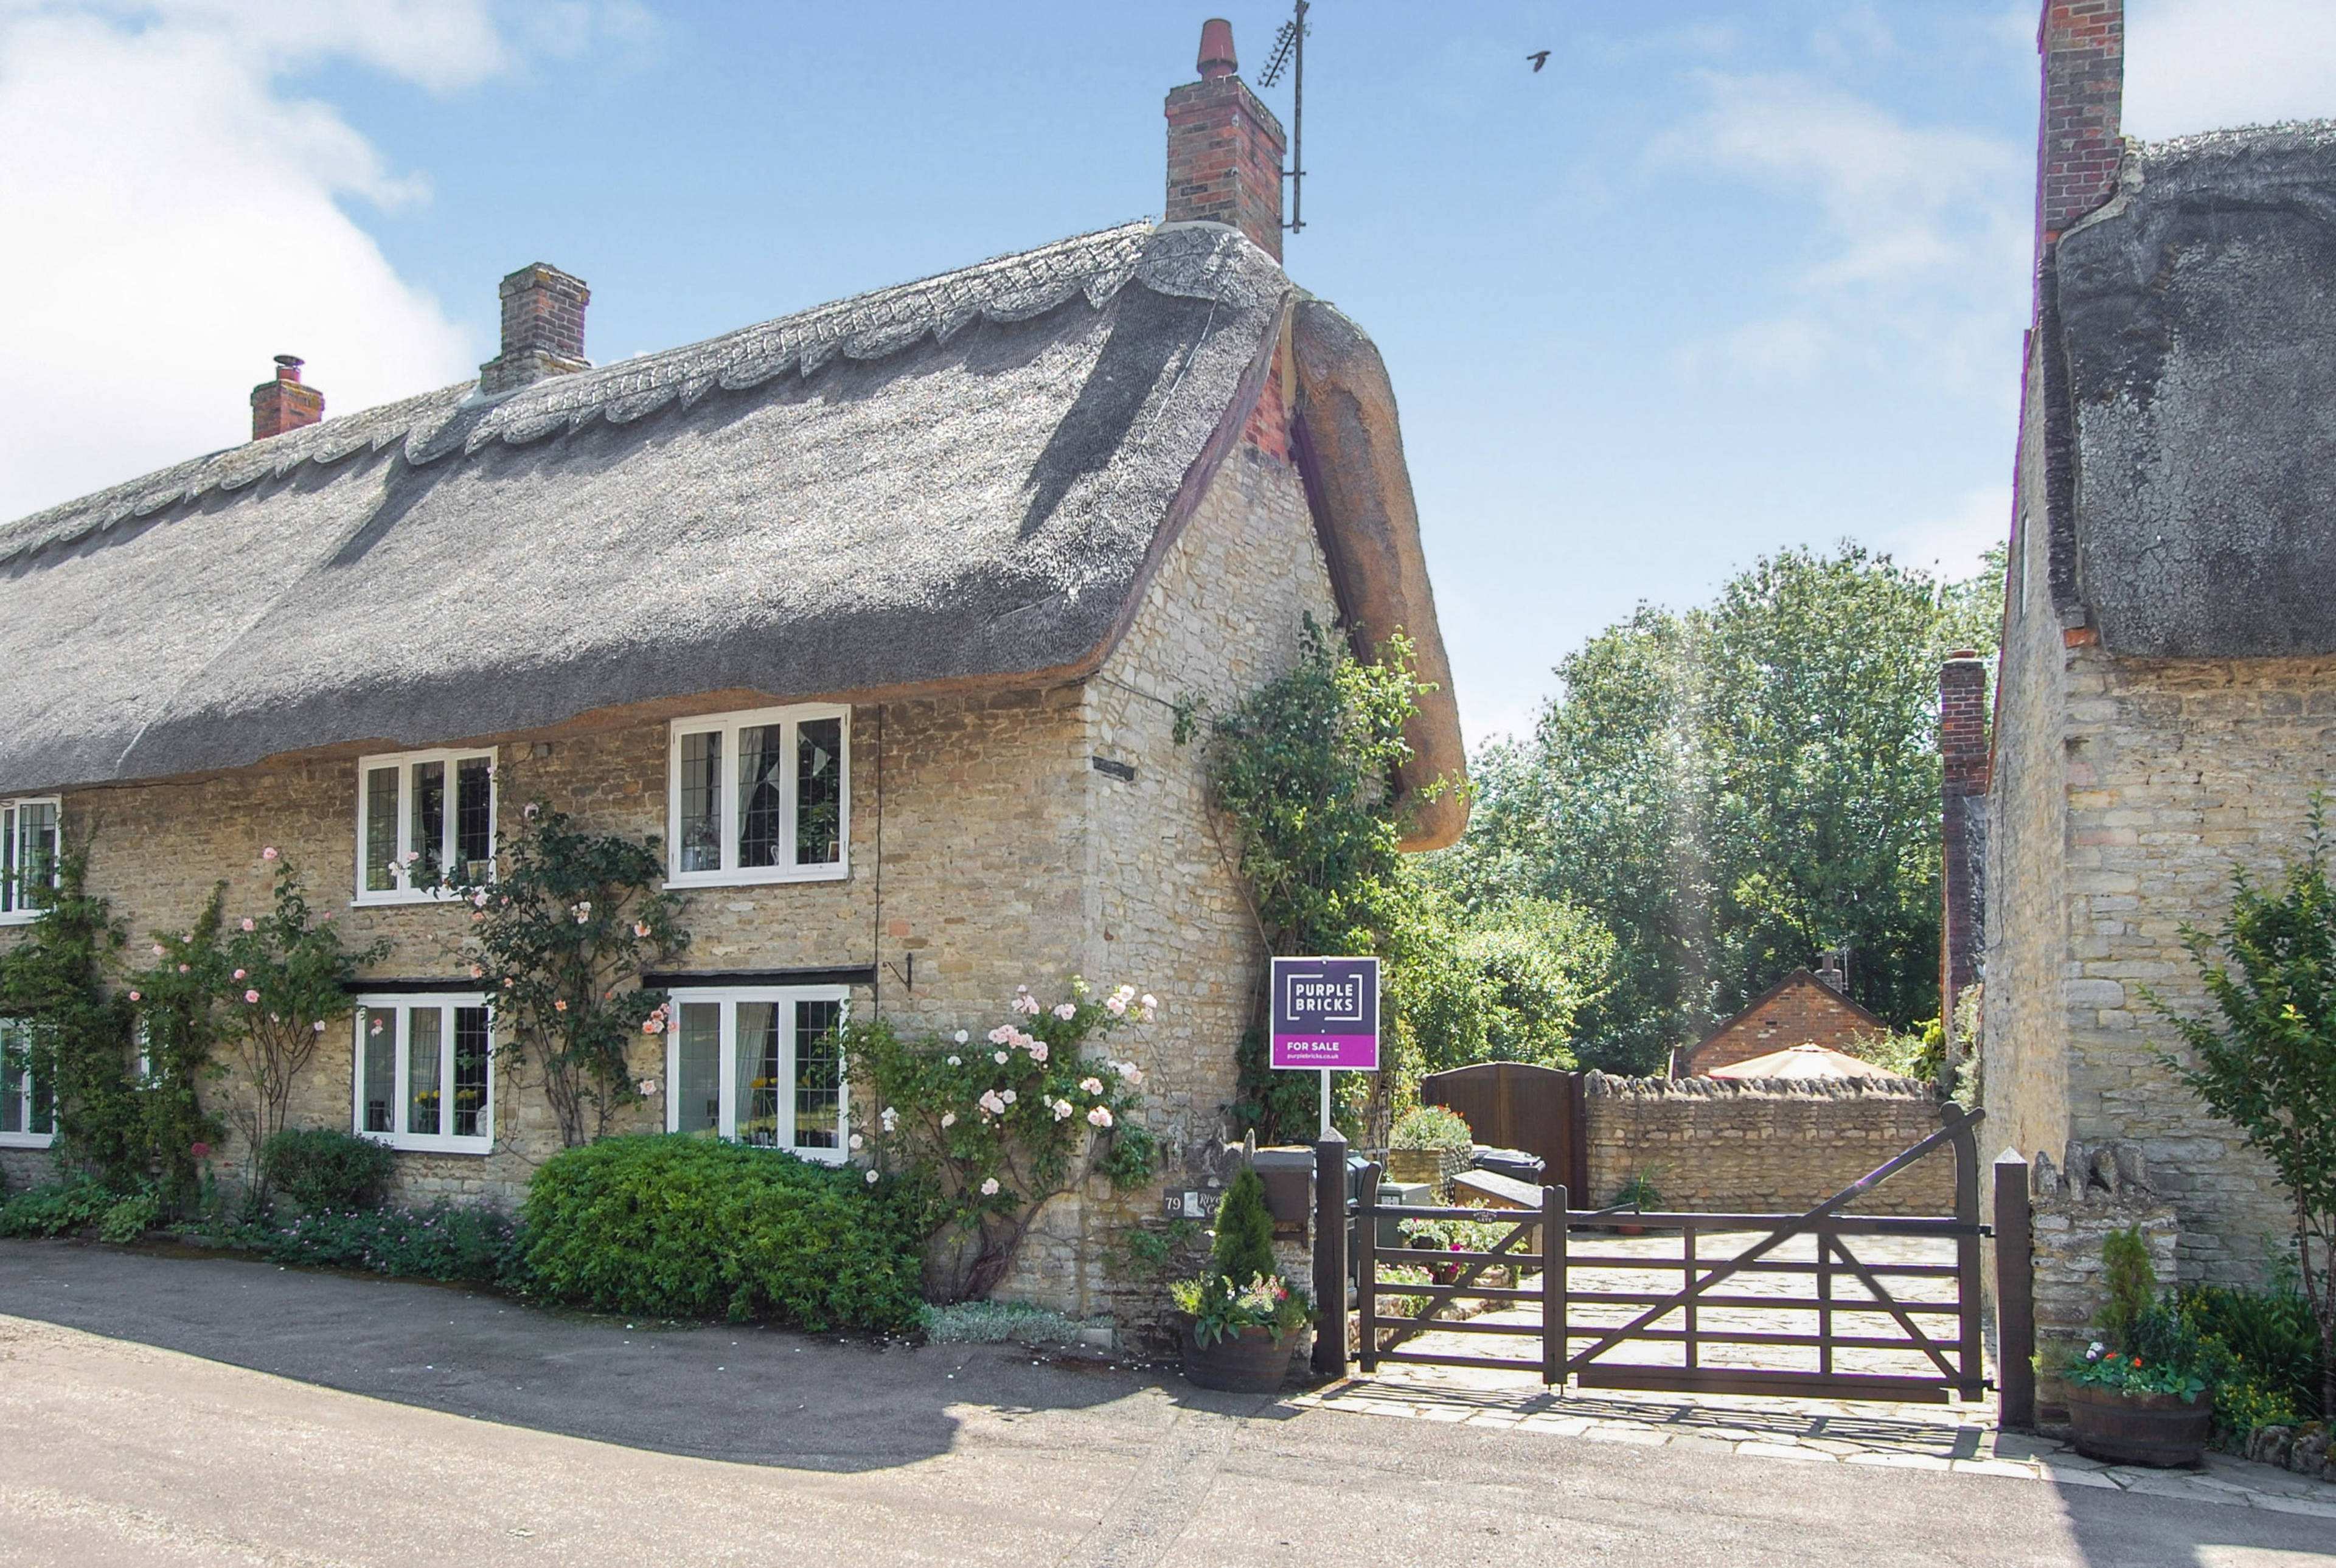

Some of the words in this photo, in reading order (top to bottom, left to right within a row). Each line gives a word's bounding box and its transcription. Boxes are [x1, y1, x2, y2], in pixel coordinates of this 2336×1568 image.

[1296, 983, 1353, 996] PURPLE
[1296, 998, 1354, 1011] BRICKS
[1287, 1042, 1309, 1050] FOR
[1312, 1042, 1340, 1051] SALE
[1166, 1197, 1181, 1210] 79
[1200, 1193, 1222, 1207] Rive
